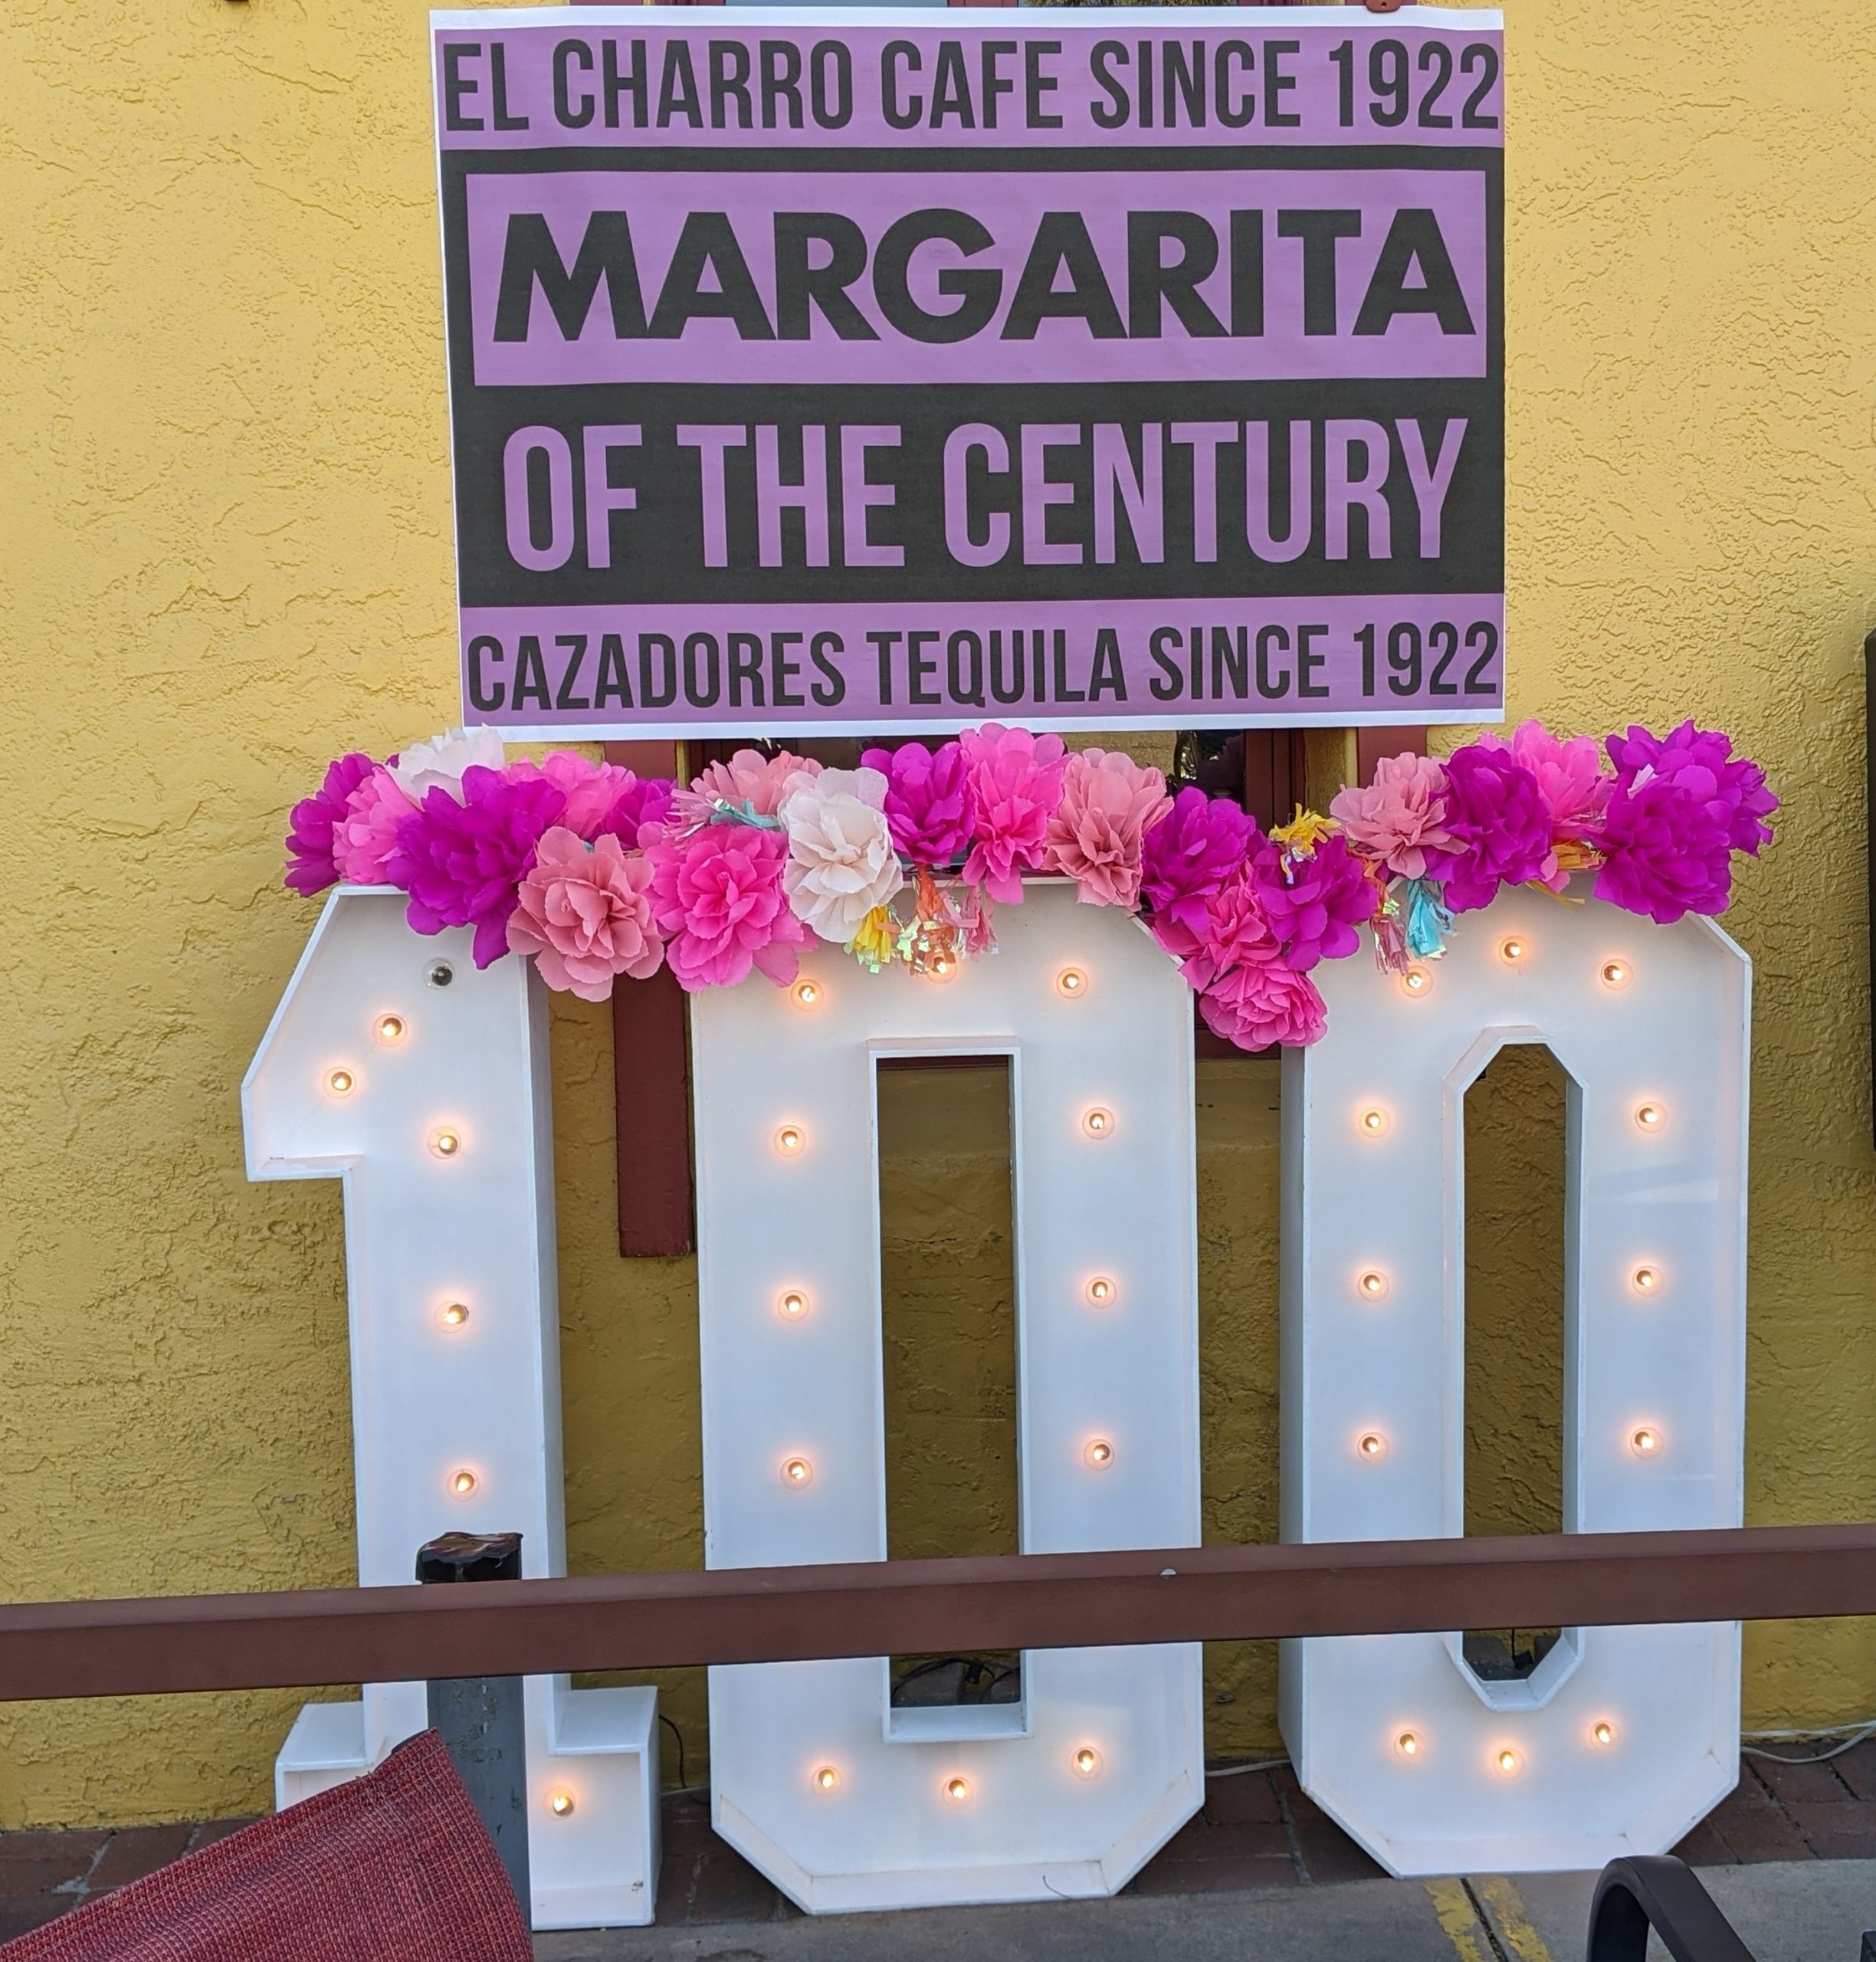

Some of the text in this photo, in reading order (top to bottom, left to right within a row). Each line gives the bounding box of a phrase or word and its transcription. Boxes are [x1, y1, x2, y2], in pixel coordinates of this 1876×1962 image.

[443, 38, 1499, 132] EL CHARRO CAFE SINCE 1922
[494, 208, 1477, 344] MARGARITA
[503, 418, 1468, 572] OF THE CENTURY
[467, 620, 1498, 712] CAZADORES TEQUILA SINCE 1922
